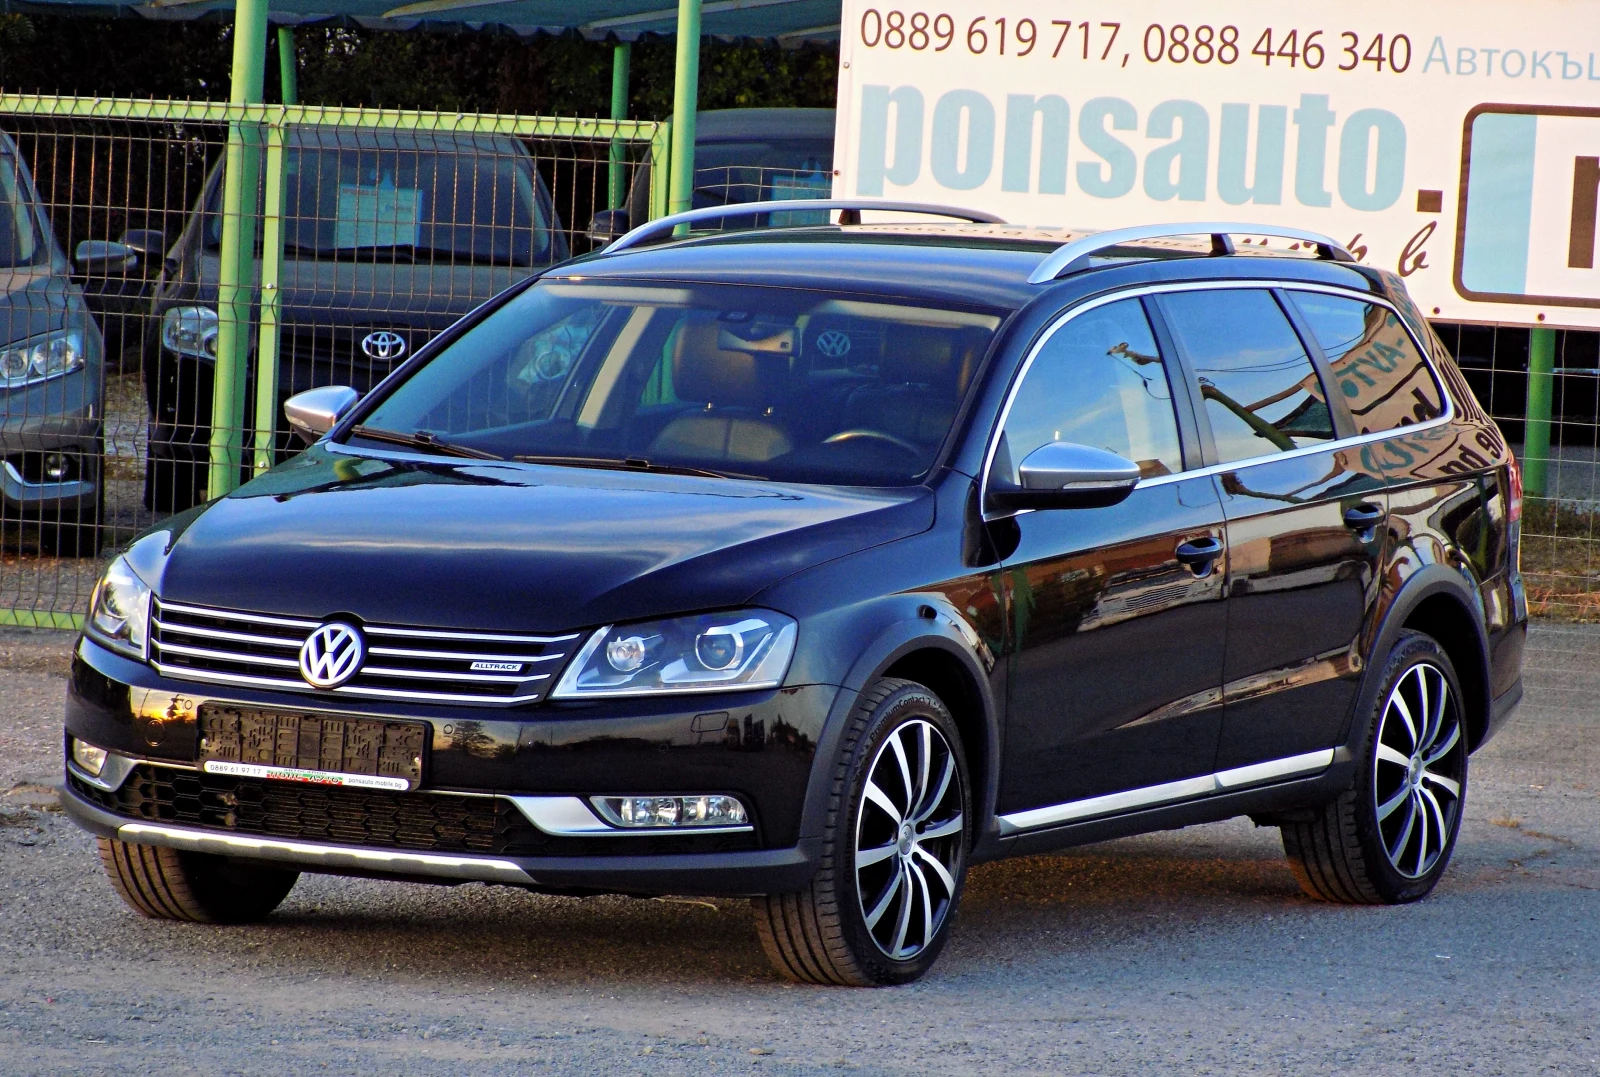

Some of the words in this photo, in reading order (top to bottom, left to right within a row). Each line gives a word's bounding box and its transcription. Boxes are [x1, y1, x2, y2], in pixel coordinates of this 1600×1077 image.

[861, 8, 954, 51] 0889
[967, 16, 1037, 57] 619
[1051, 19, 1130, 68] 717,
[1143, 23, 1240, 64] 0888
[1251, 27, 1325, 69] 446
[1338, 31, 1411, 74] 340
[210, 764, 229, 772] 0889
